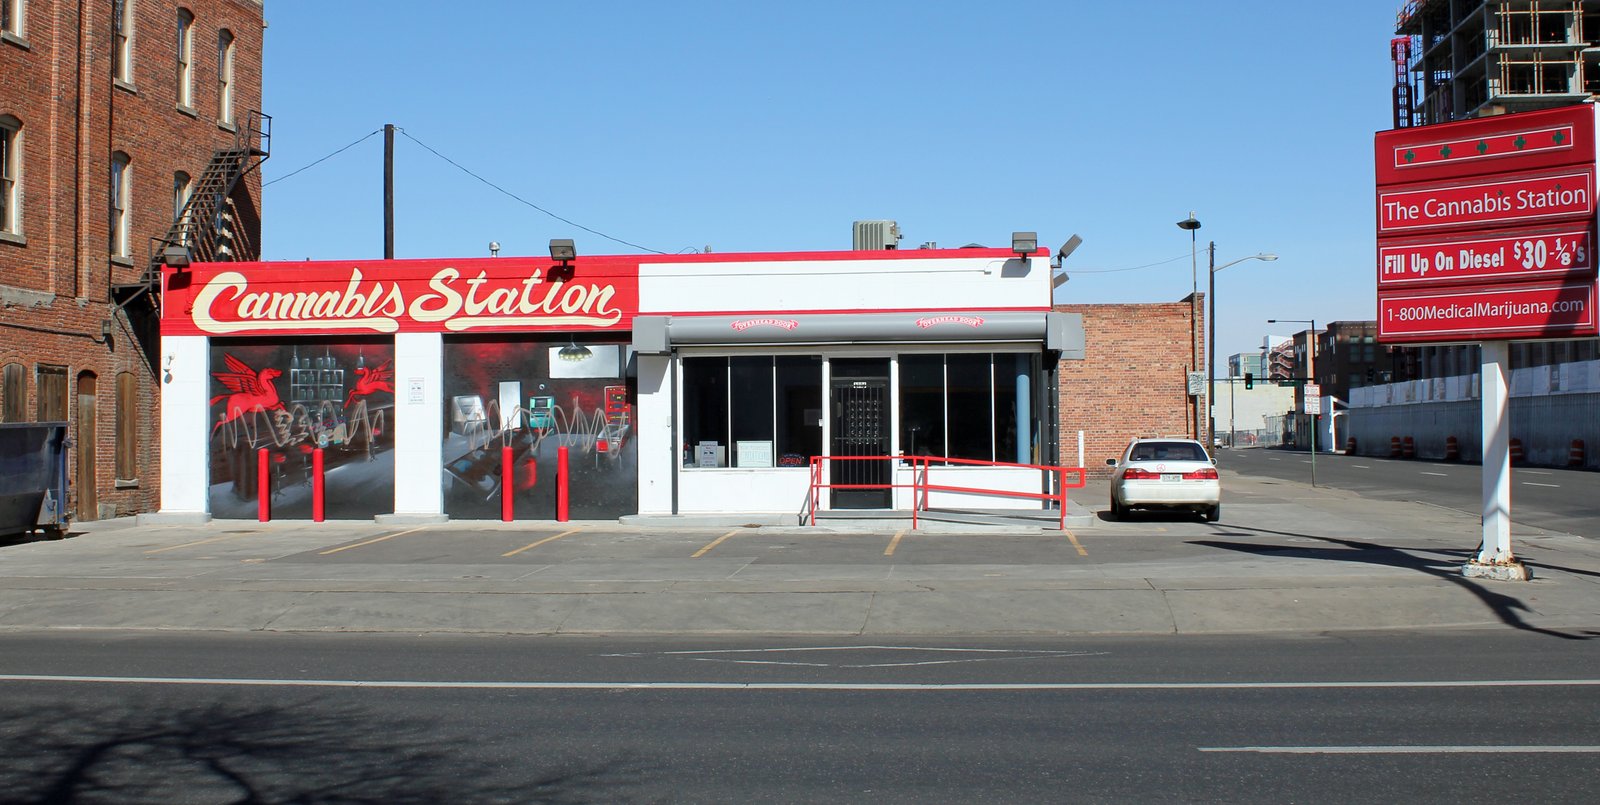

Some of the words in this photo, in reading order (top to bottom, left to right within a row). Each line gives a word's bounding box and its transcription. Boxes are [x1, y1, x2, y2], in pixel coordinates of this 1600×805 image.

[1384, 202, 1419, 221] The
[1424, 191, 1511, 219] Cannabis
[1516, 186, 1586, 210] Station
[1384, 254, 1405, 274] Fill
[1410, 252, 1429, 276] Up
[1435, 251, 1454, 271] On
[1459, 247, 1504, 270] Diesel
[191, 267, 405, 333] Cannabis
[408, 267, 622, 332] Station
[1387, 300, 1584, 322] 1-800MedicalMarijuana.com
[779, 457, 802, 465] OPEN
